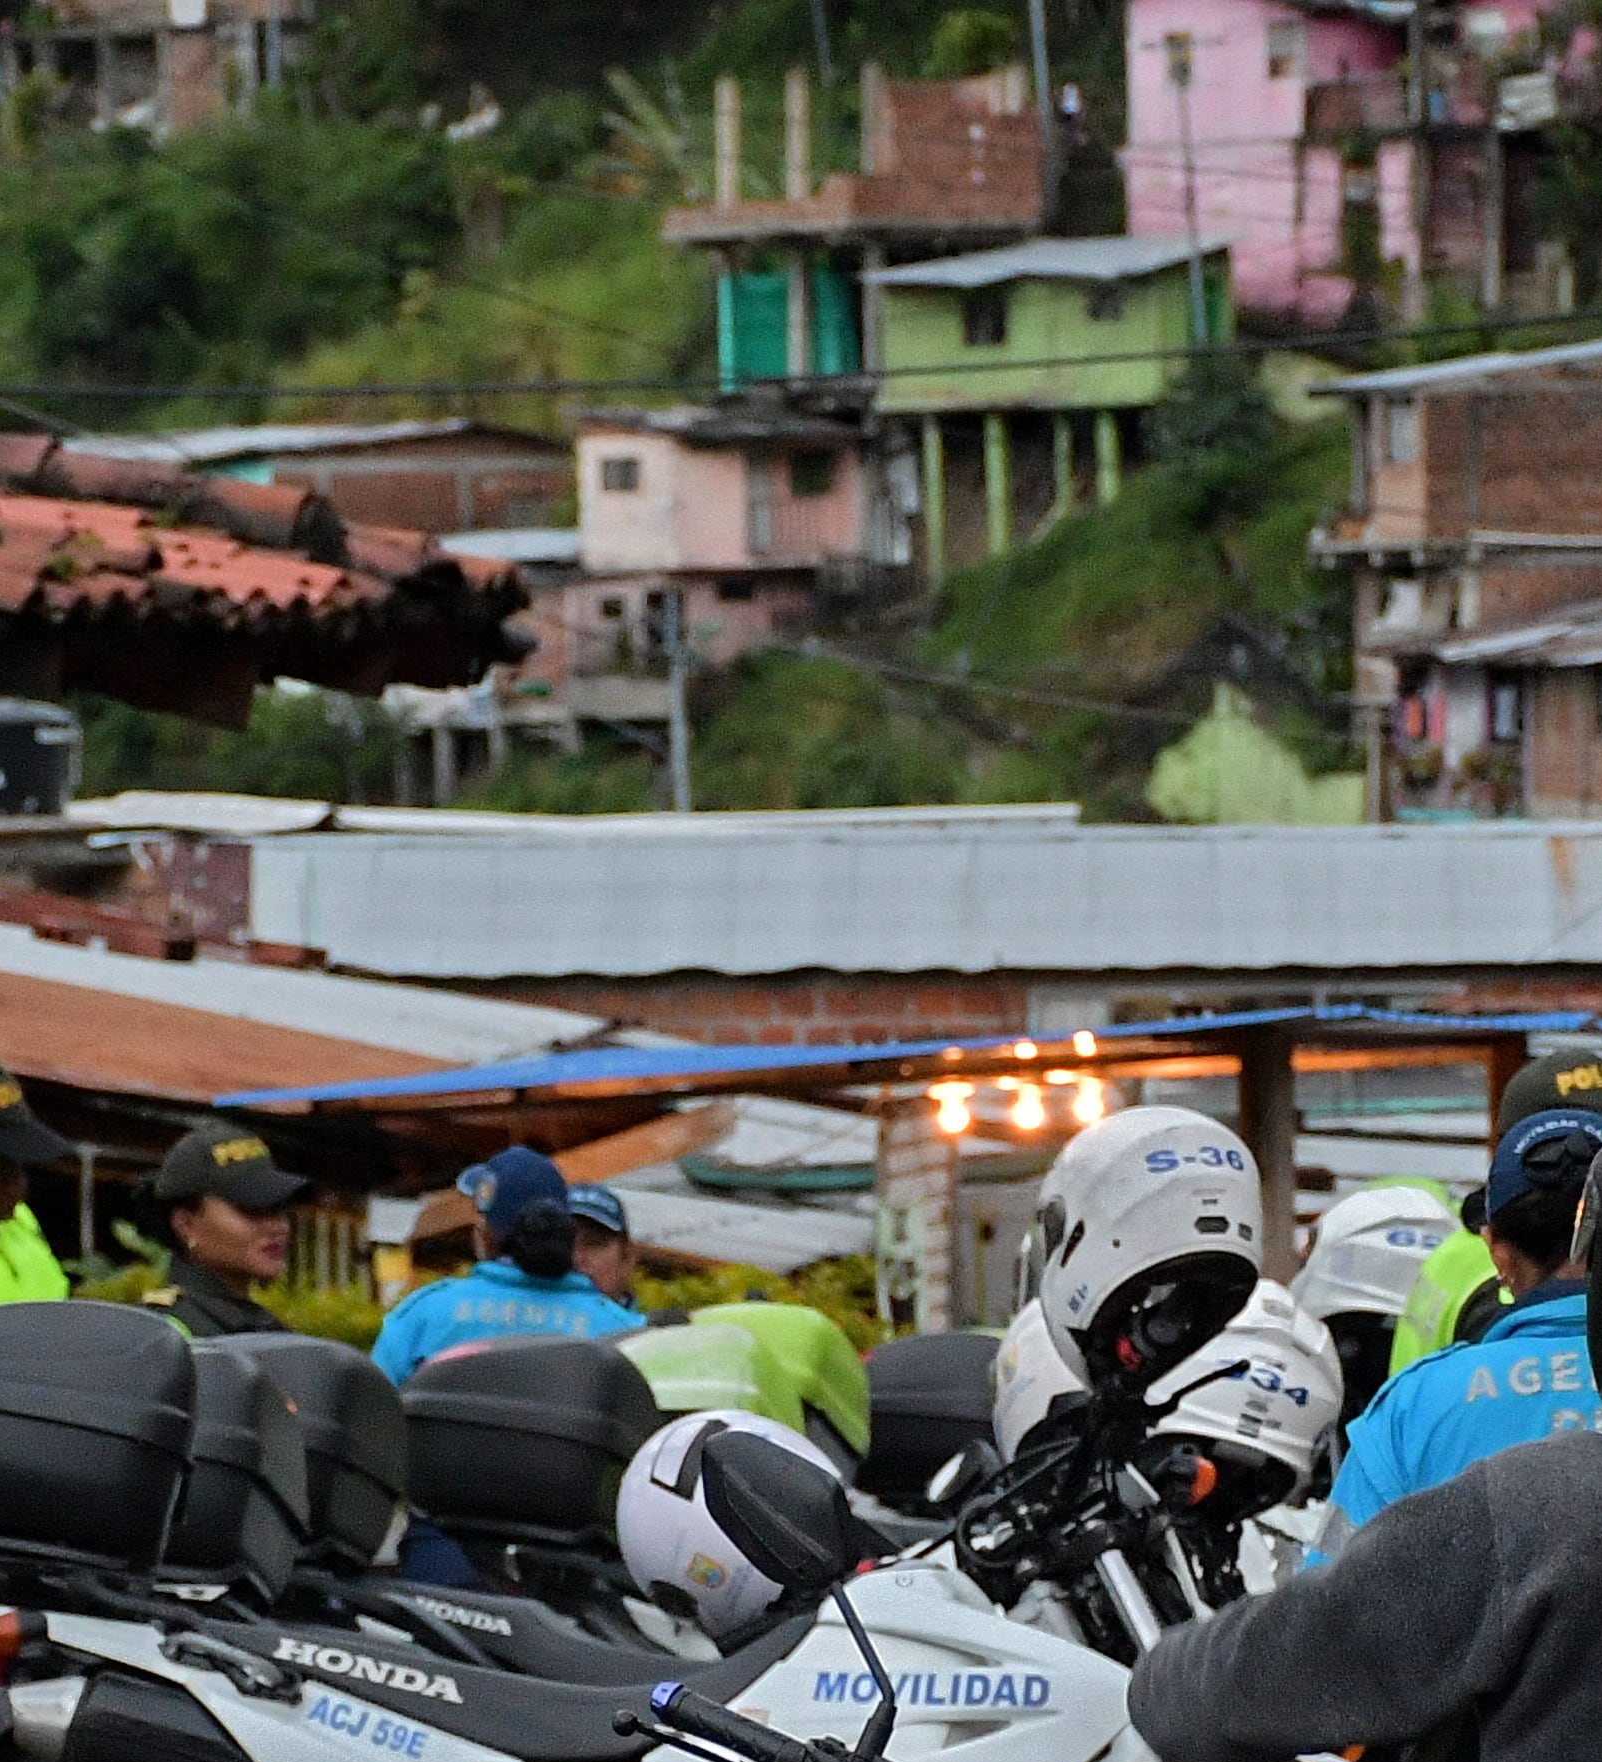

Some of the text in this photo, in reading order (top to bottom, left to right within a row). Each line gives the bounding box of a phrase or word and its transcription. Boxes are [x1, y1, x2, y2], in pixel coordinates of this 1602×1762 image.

[273, 1637, 465, 1705] HONDA
[309, 1695, 427, 1760] ACJ 59E
